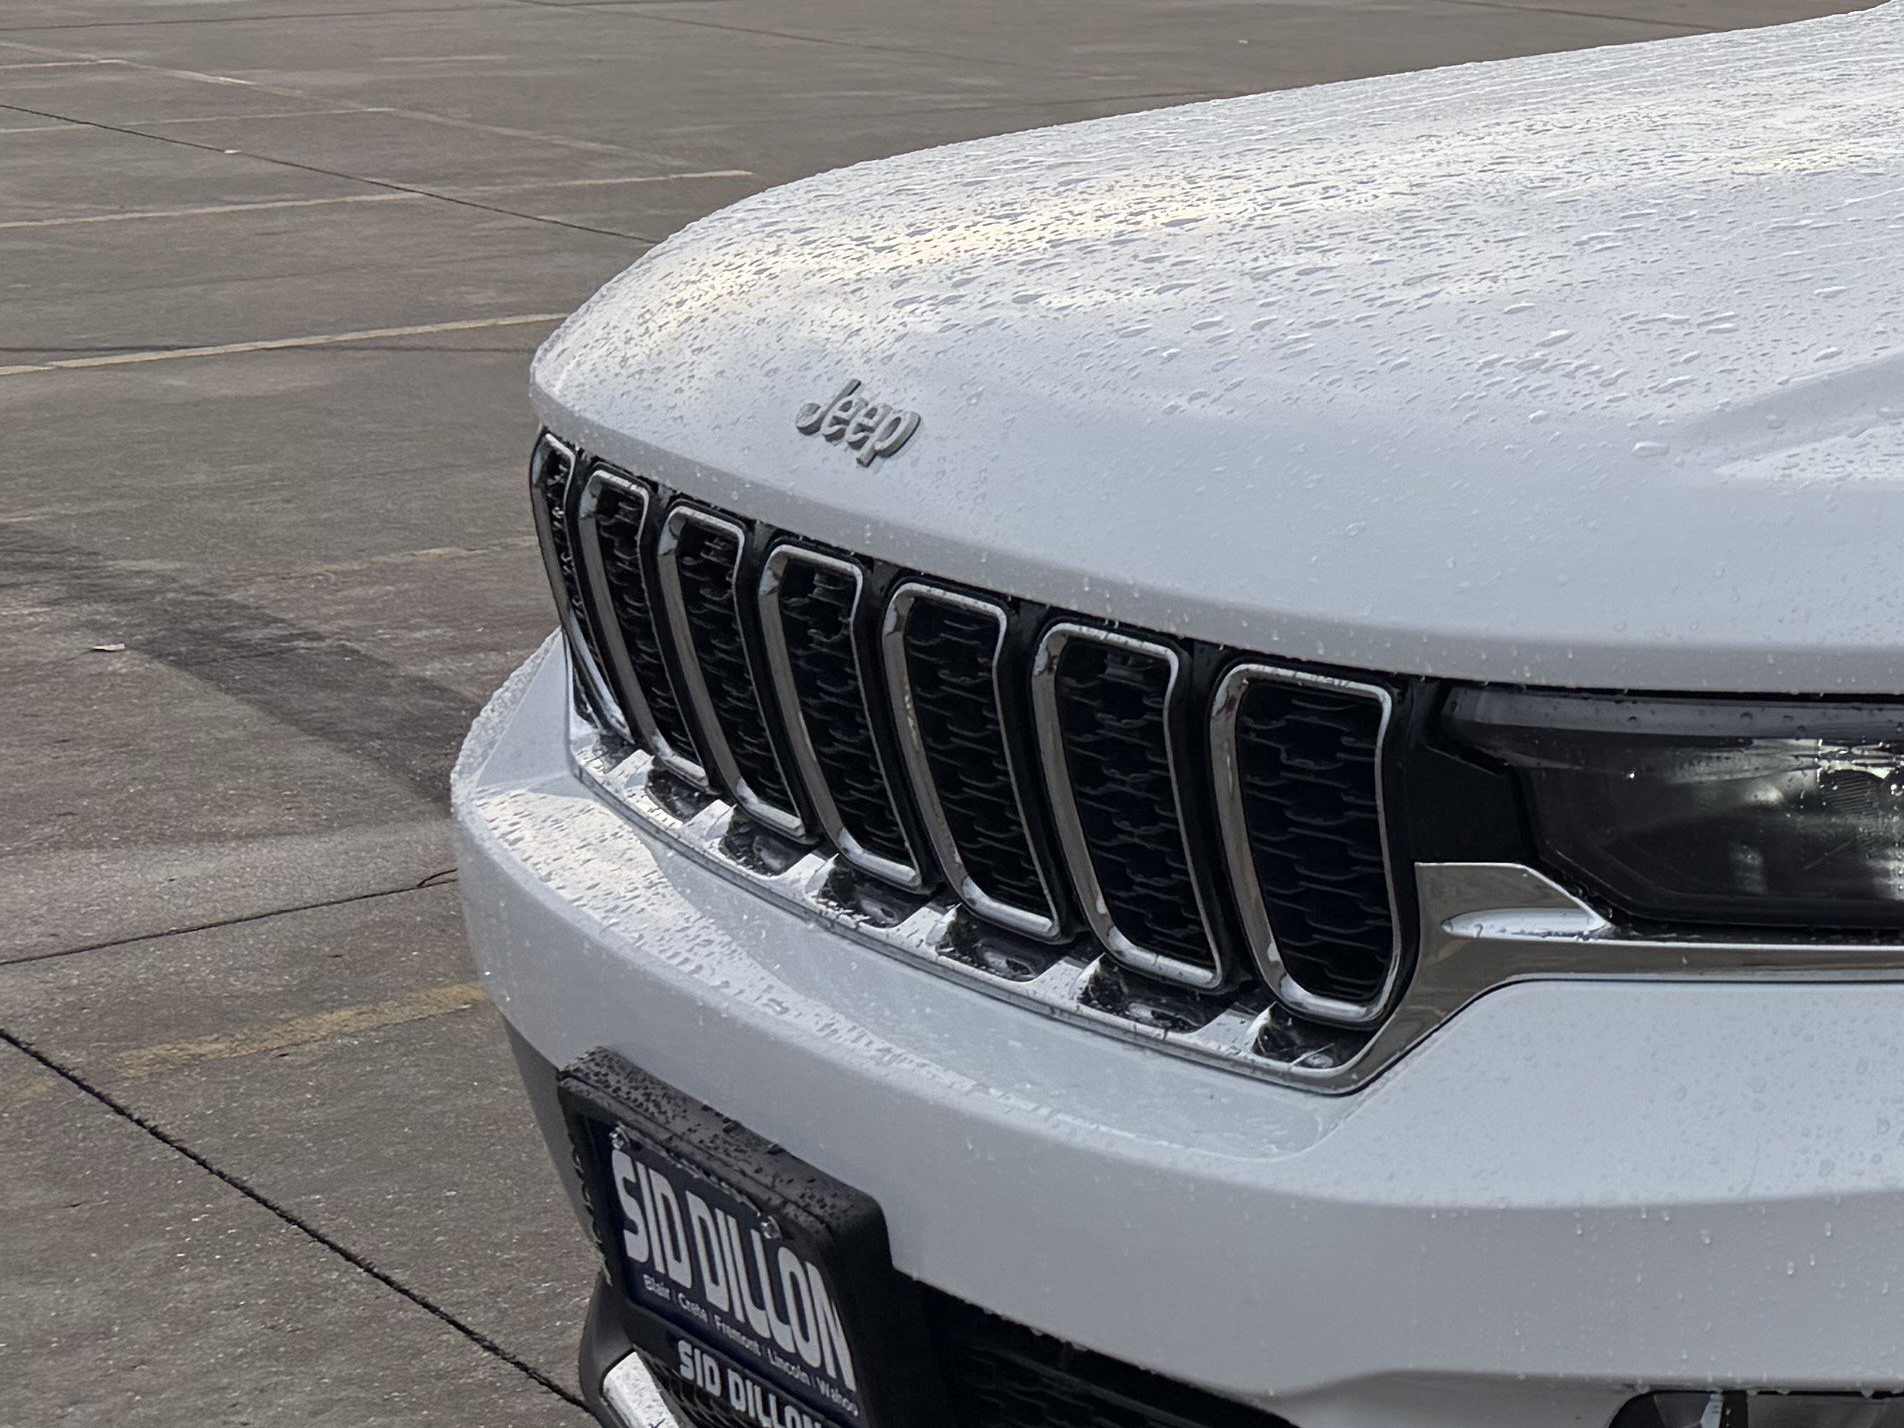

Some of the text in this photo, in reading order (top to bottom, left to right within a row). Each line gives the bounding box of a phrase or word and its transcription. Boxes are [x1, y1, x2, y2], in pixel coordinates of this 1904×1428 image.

[795, 378, 922, 468] Jeep
[612, 1148, 857, 1393] SID DILLON
[677, 1339, 722, 1398] SID
